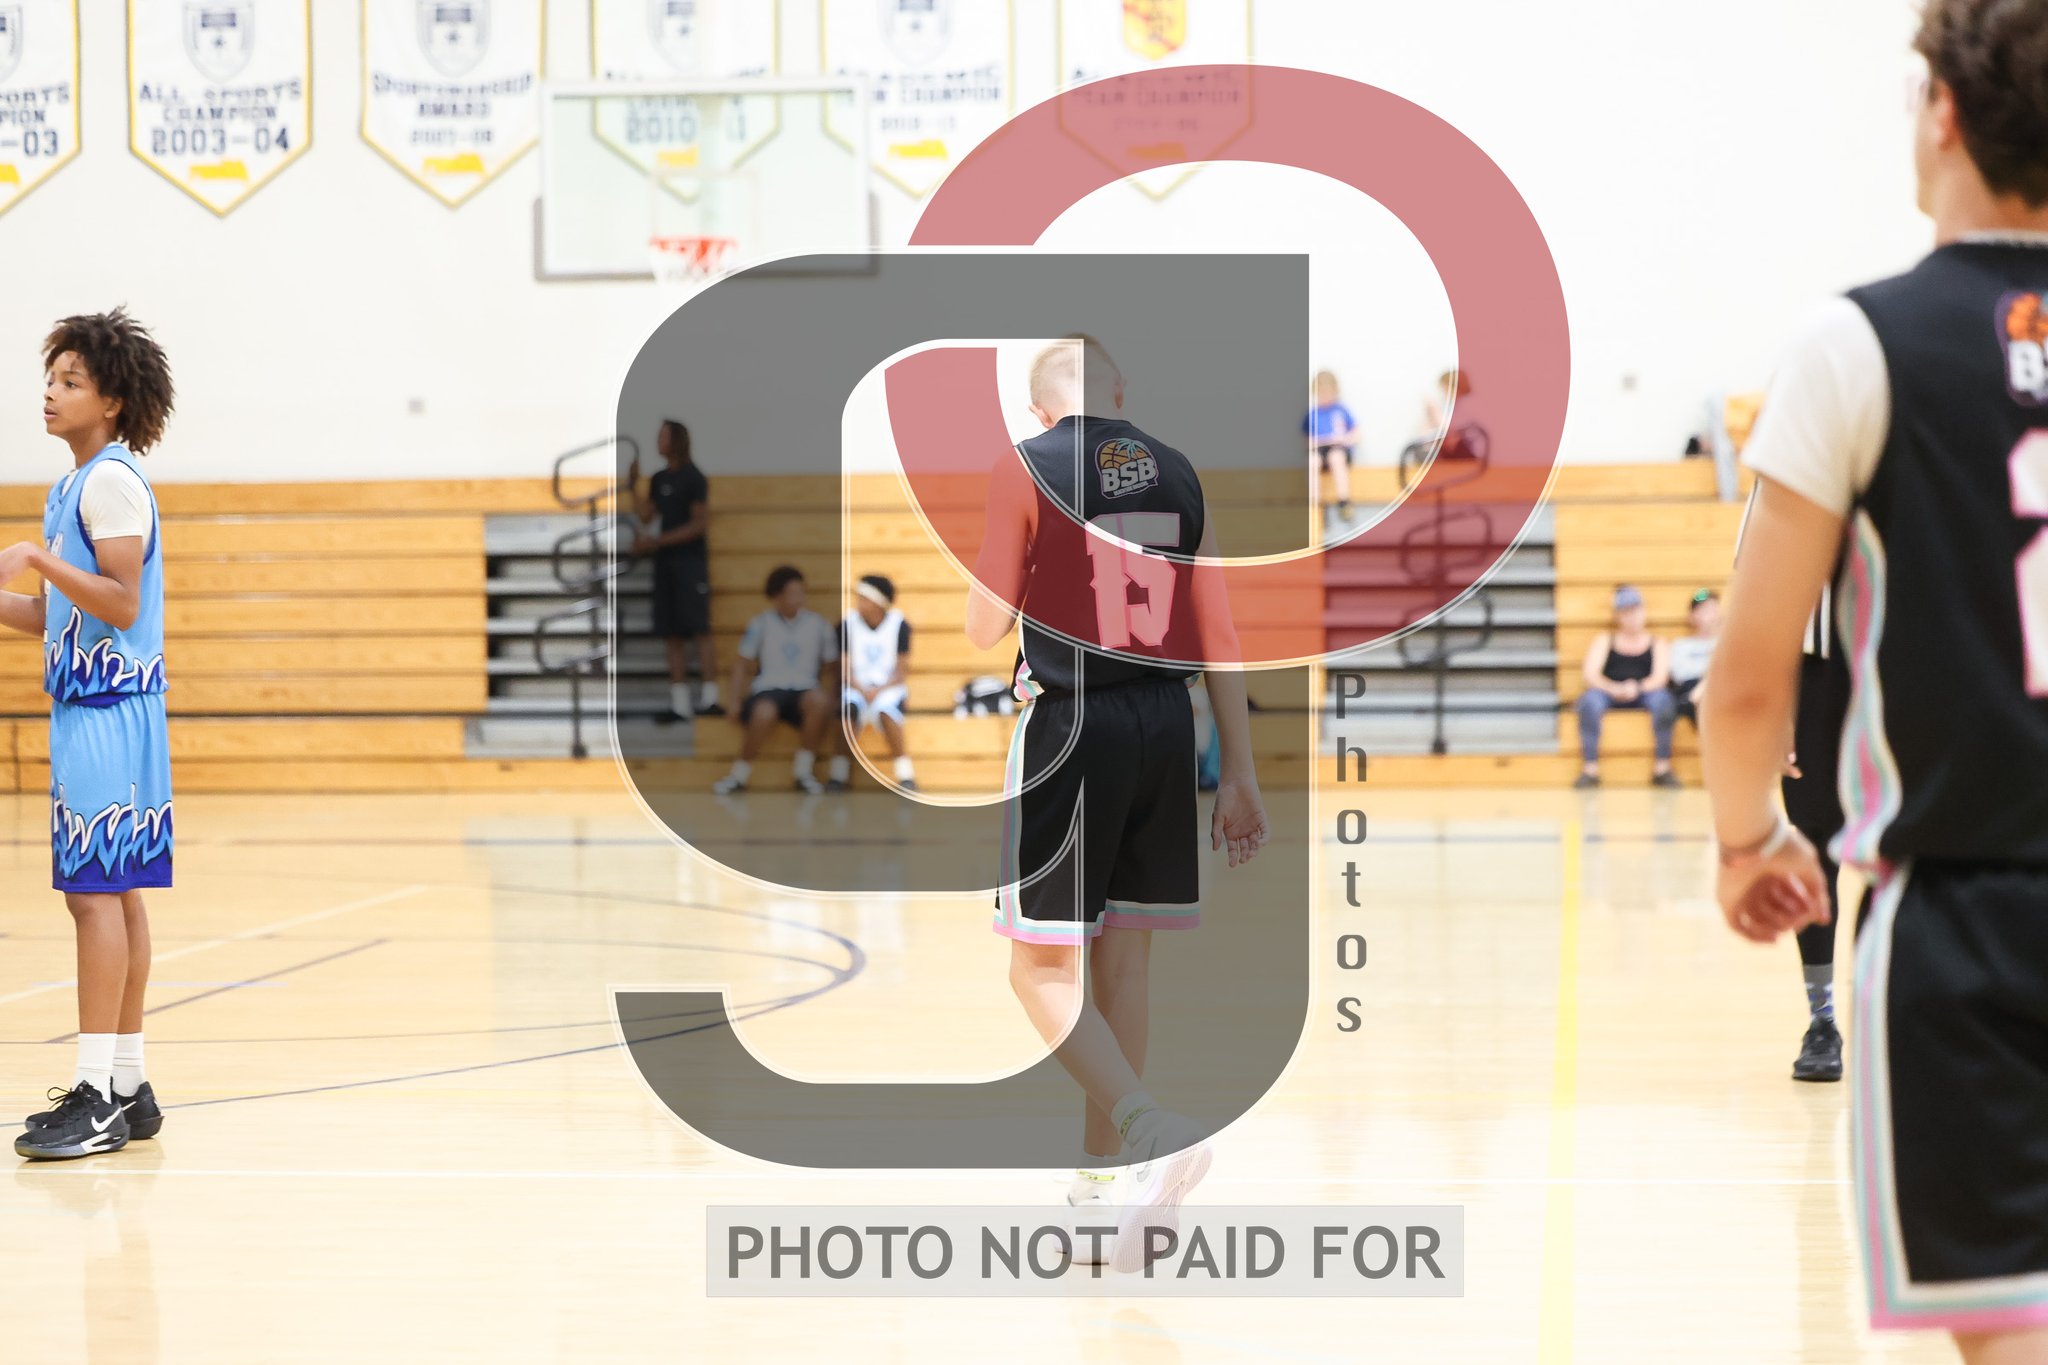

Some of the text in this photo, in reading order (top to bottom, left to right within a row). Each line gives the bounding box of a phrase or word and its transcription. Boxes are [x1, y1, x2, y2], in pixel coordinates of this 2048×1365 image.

[139, 78, 301, 106] ALL SPORTS
[163, 107, 276, 121] CHAMPION
[152, 127, 289, 154] 2003-04
[1101, 458, 1157, 493] BSB
[1085, 512, 1181, 649] 15
